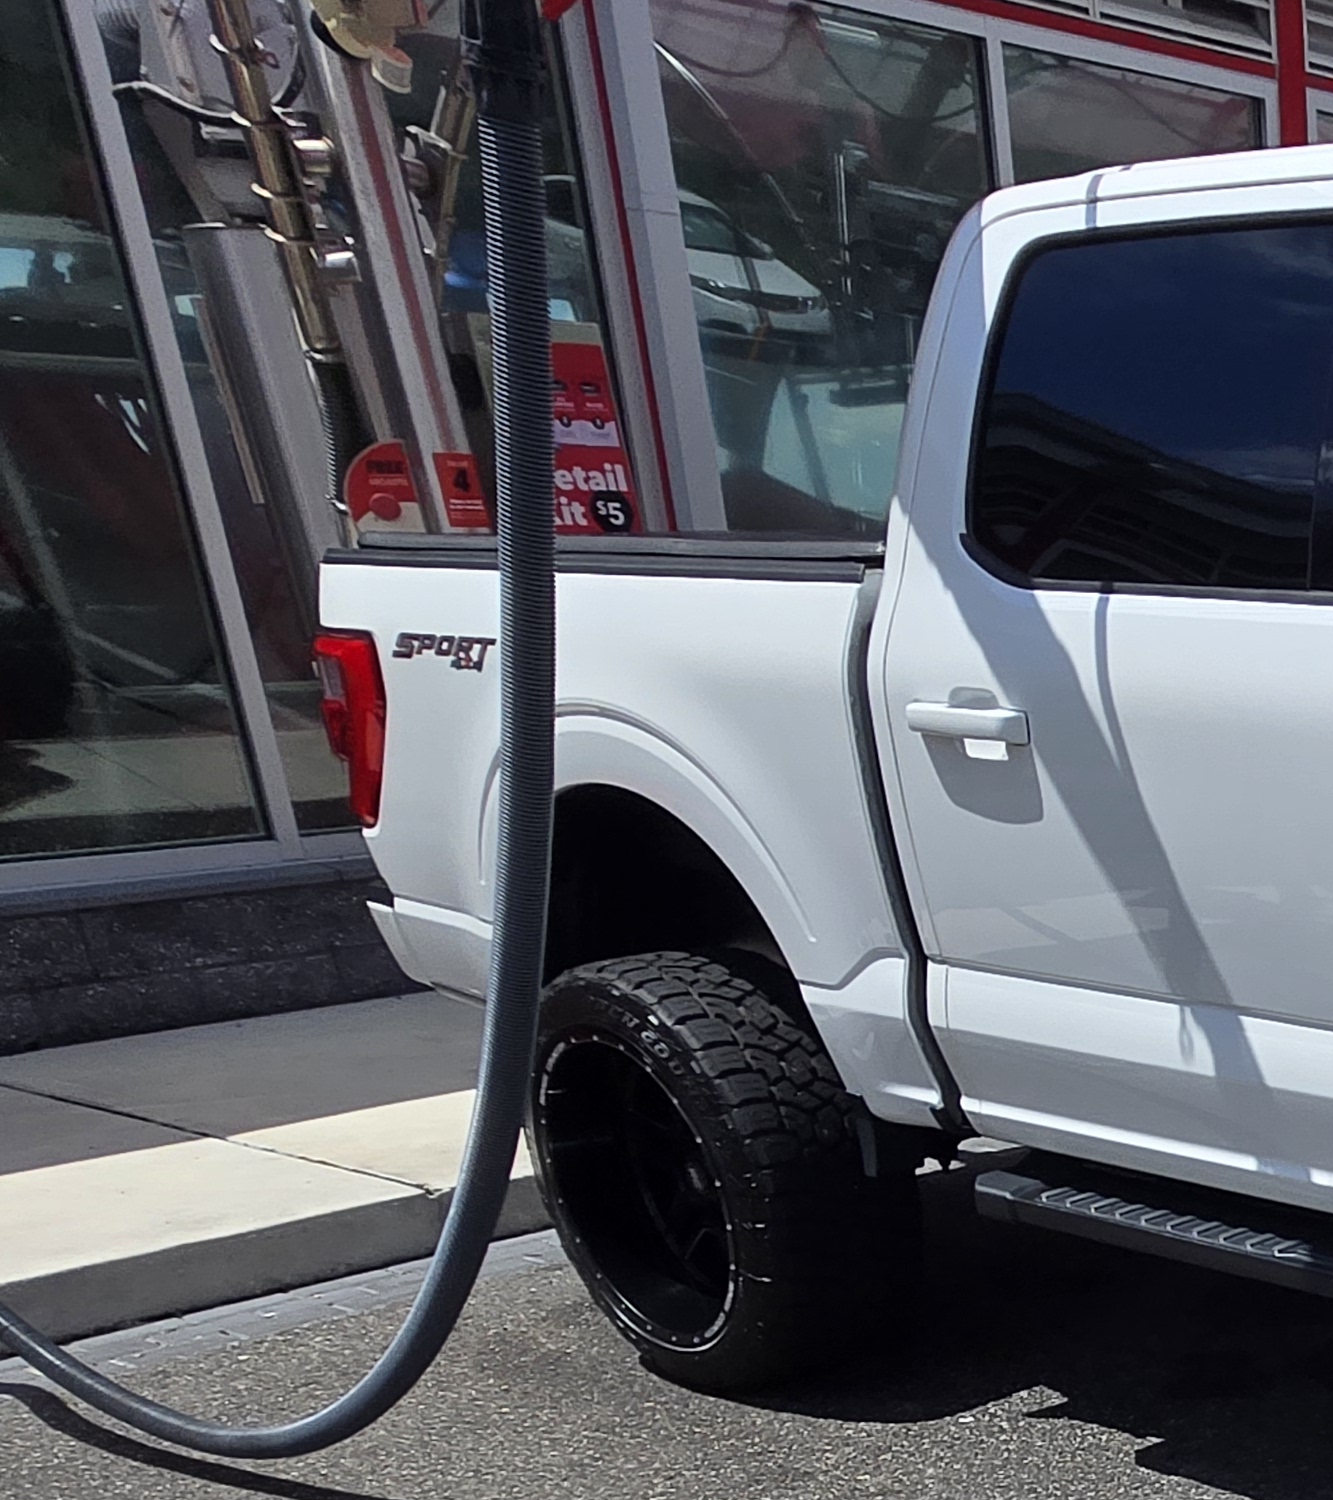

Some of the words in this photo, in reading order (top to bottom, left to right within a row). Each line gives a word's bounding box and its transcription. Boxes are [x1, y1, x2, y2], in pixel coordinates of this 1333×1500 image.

[553, 462, 629, 492] etail
[596, 501, 625, 526] $5
[392, 631, 497, 662] SPORT
